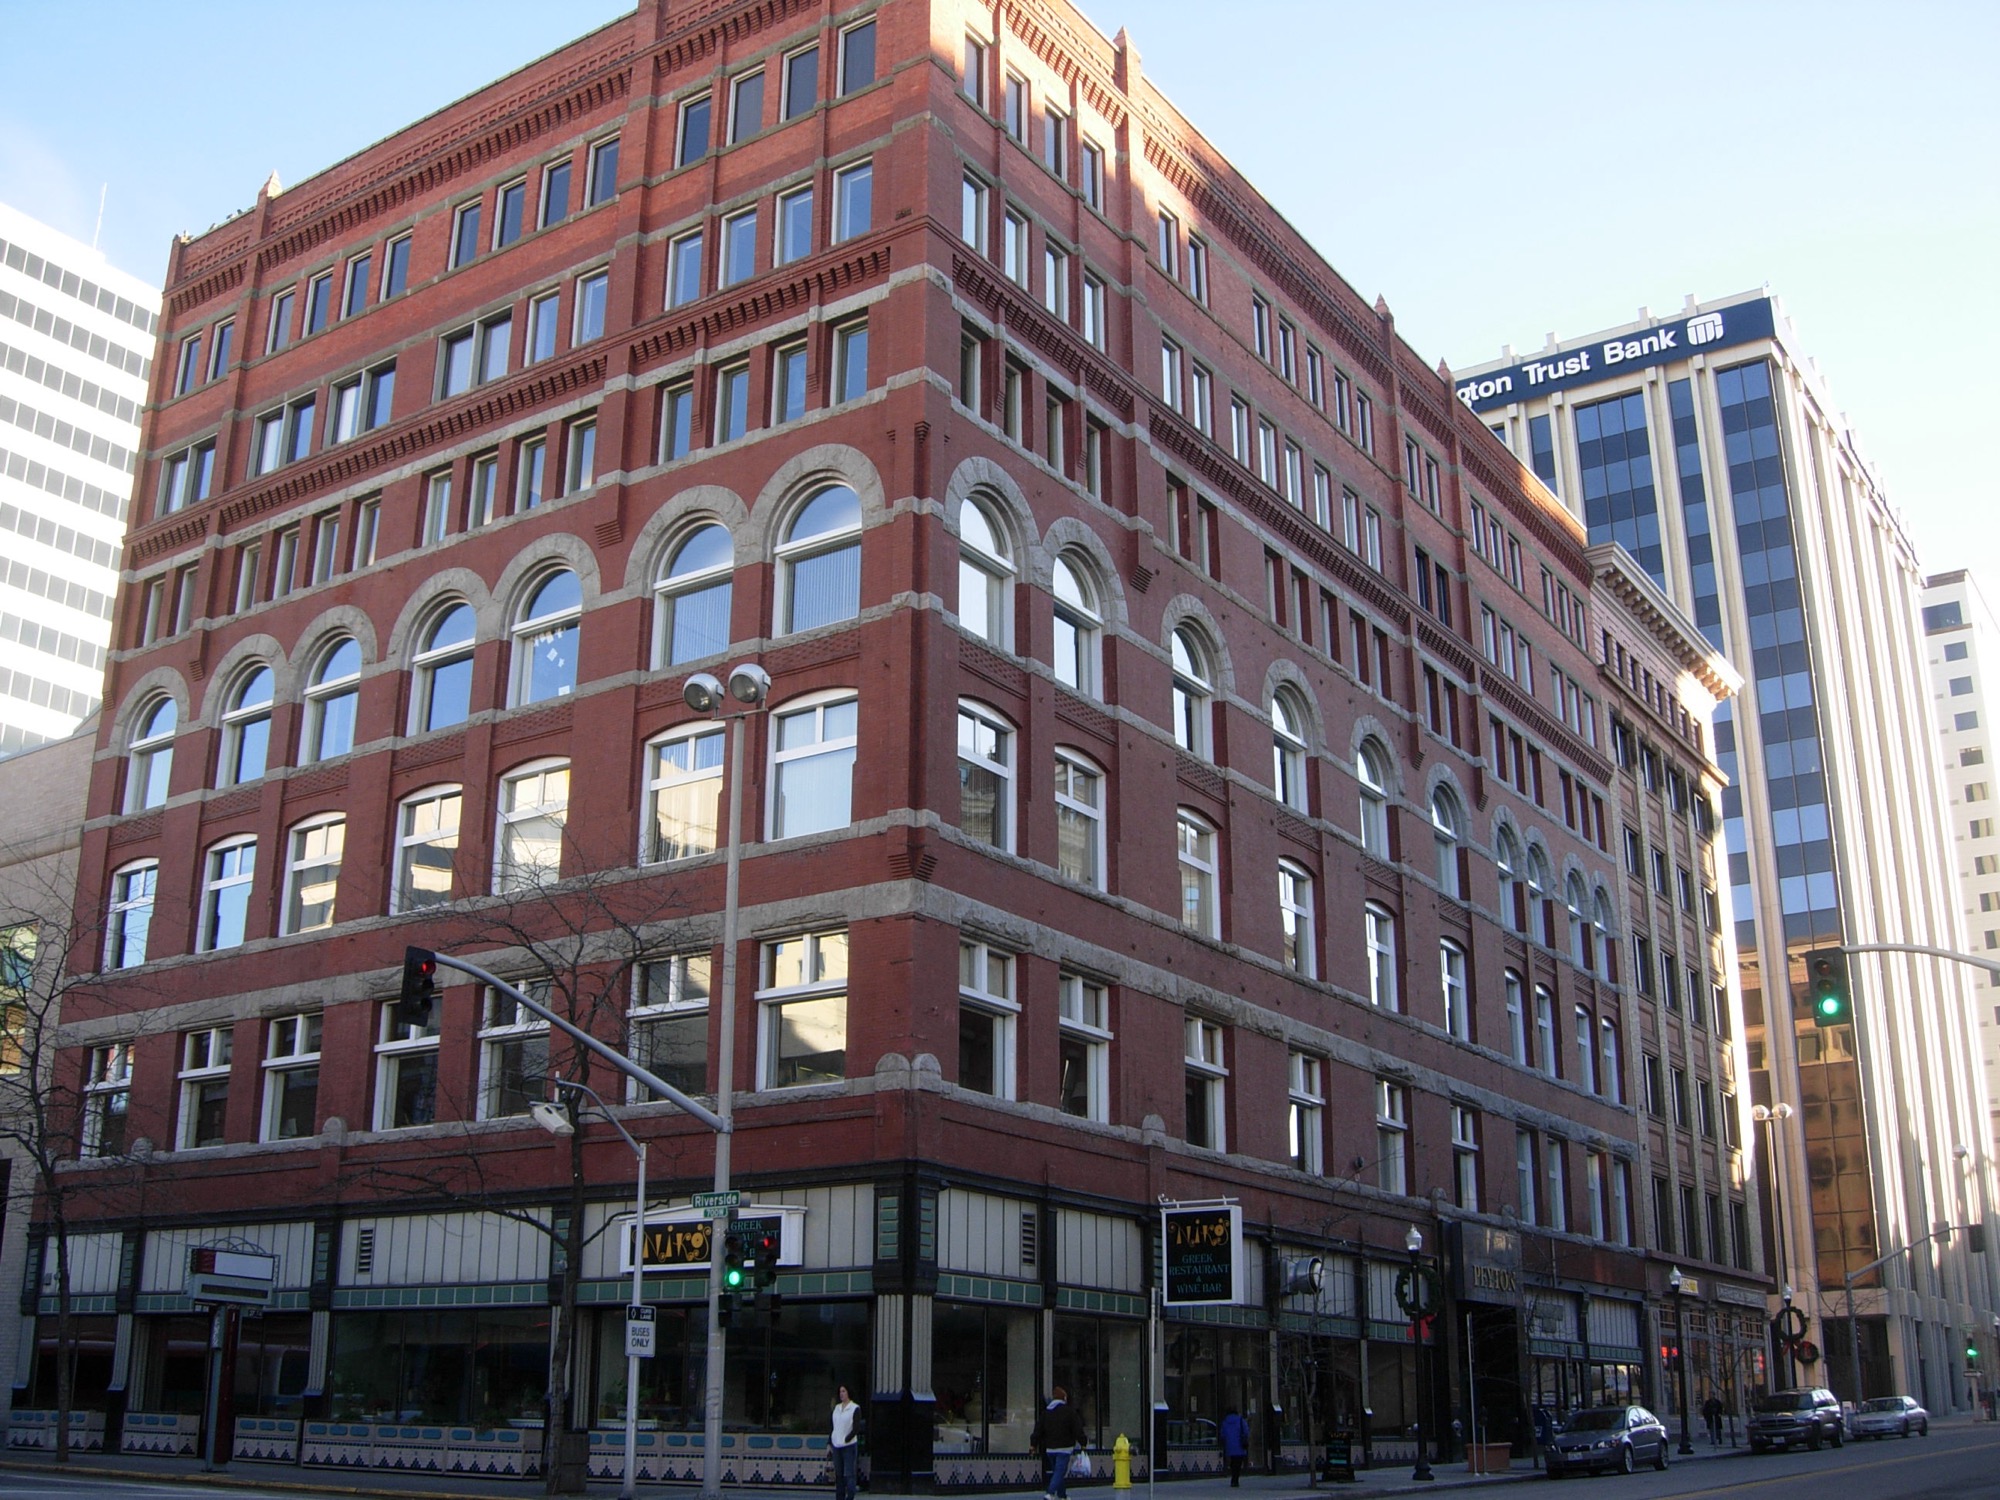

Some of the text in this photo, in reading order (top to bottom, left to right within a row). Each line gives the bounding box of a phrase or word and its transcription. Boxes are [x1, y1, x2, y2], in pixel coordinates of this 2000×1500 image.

[1522, 351, 1591, 385] Trust
[1603, 329, 1678, 365] Bank
[694, 1193, 738, 1207] Riverside
[730, 1219, 763, 1231] GREEK
[1182, 1253, 1213, 1264] GREEK
[1169, 1264, 1230, 1276] RESTAURANT
[1473, 1265, 1516, 1292] PEYTON
[1177, 1282, 1223, 1294] WINE BAR
[631, 1326, 650, 1337] BUSES
[631, 1338, 650, 1347] ONLY
